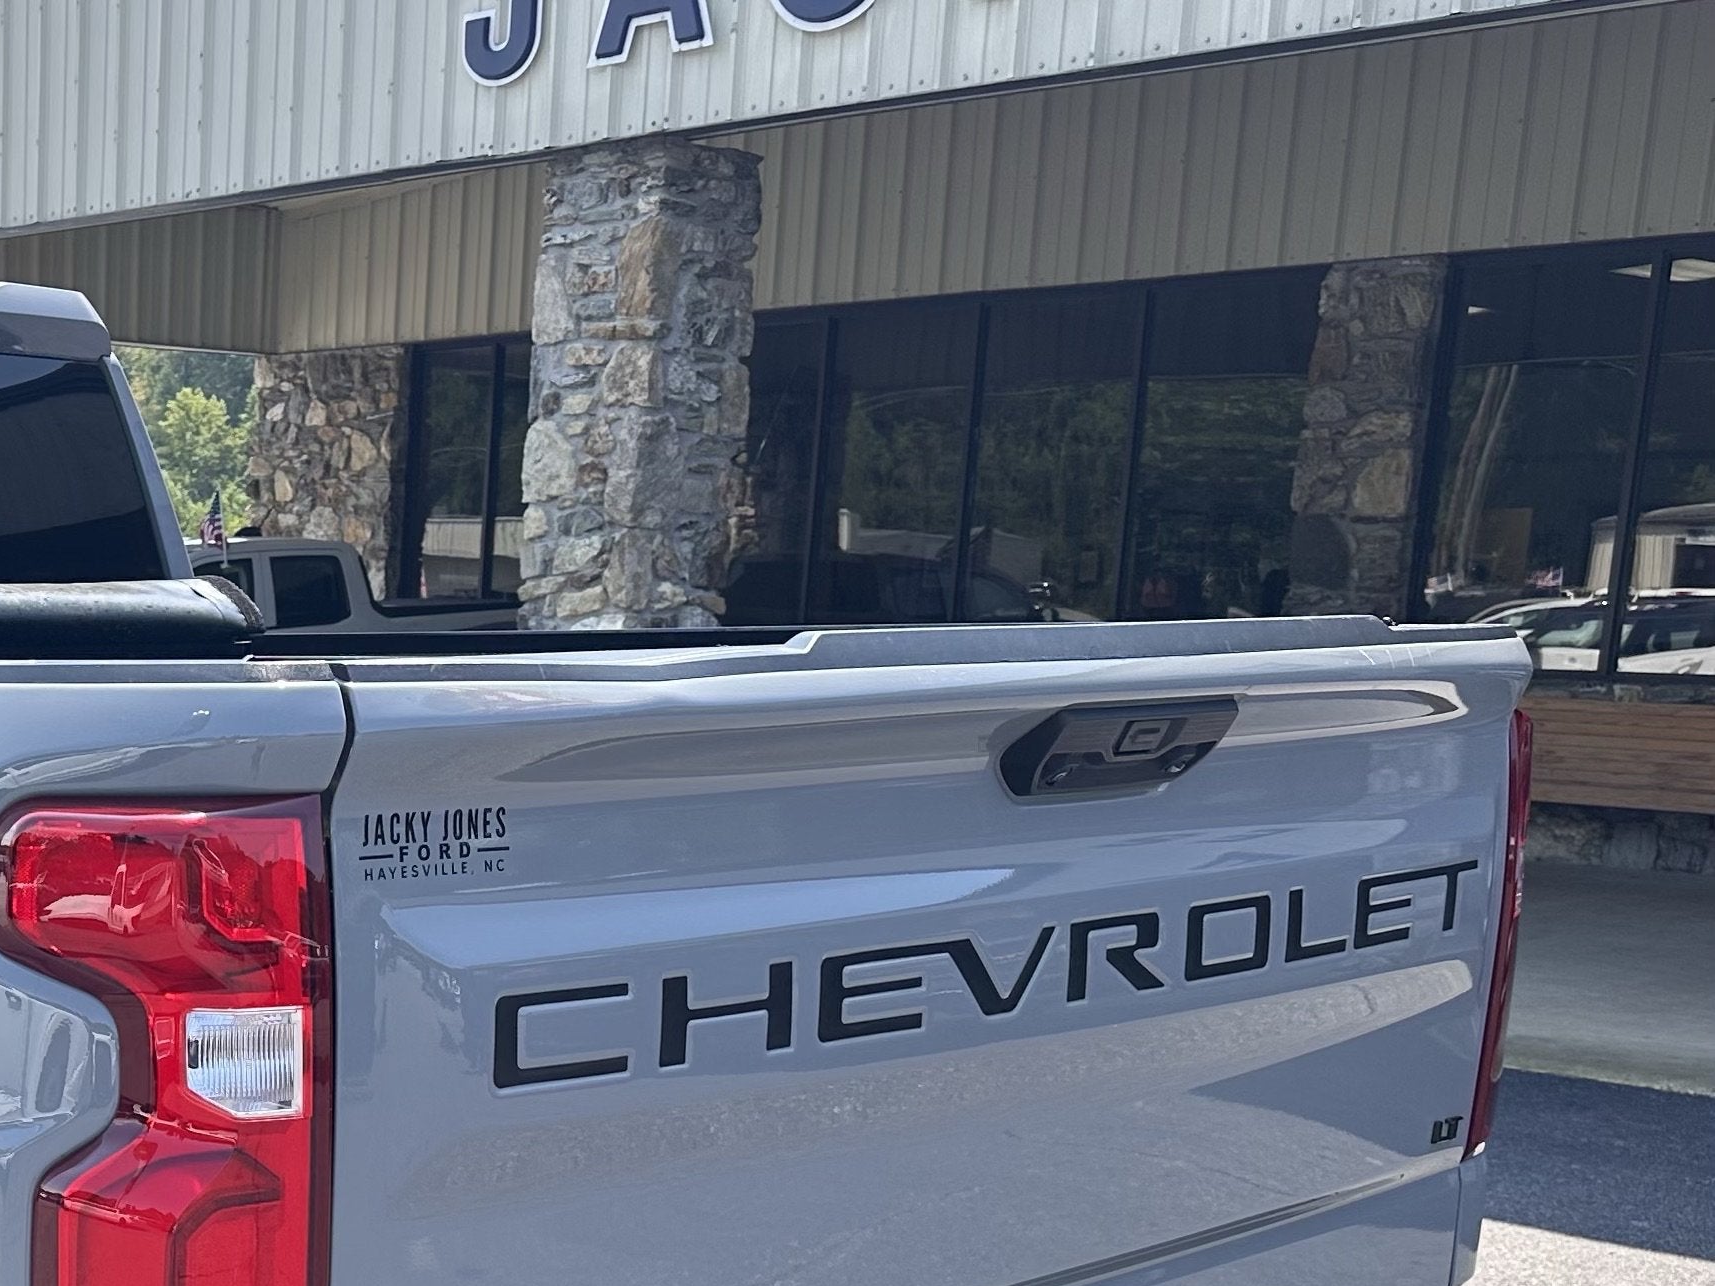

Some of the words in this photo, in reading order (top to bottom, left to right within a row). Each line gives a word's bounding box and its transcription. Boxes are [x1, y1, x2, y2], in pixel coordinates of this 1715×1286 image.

[362, 811, 432, 847] JACKY
[442, 806, 507, 842] JONES
[398, 841, 471, 863] FORD
[364, 861, 475, 882] HAYESVILLE,
[484, 858, 505, 873] NC
[494, 859, 1479, 1089] CHEVROLET
[1430, 1115, 1464, 1144] LT
